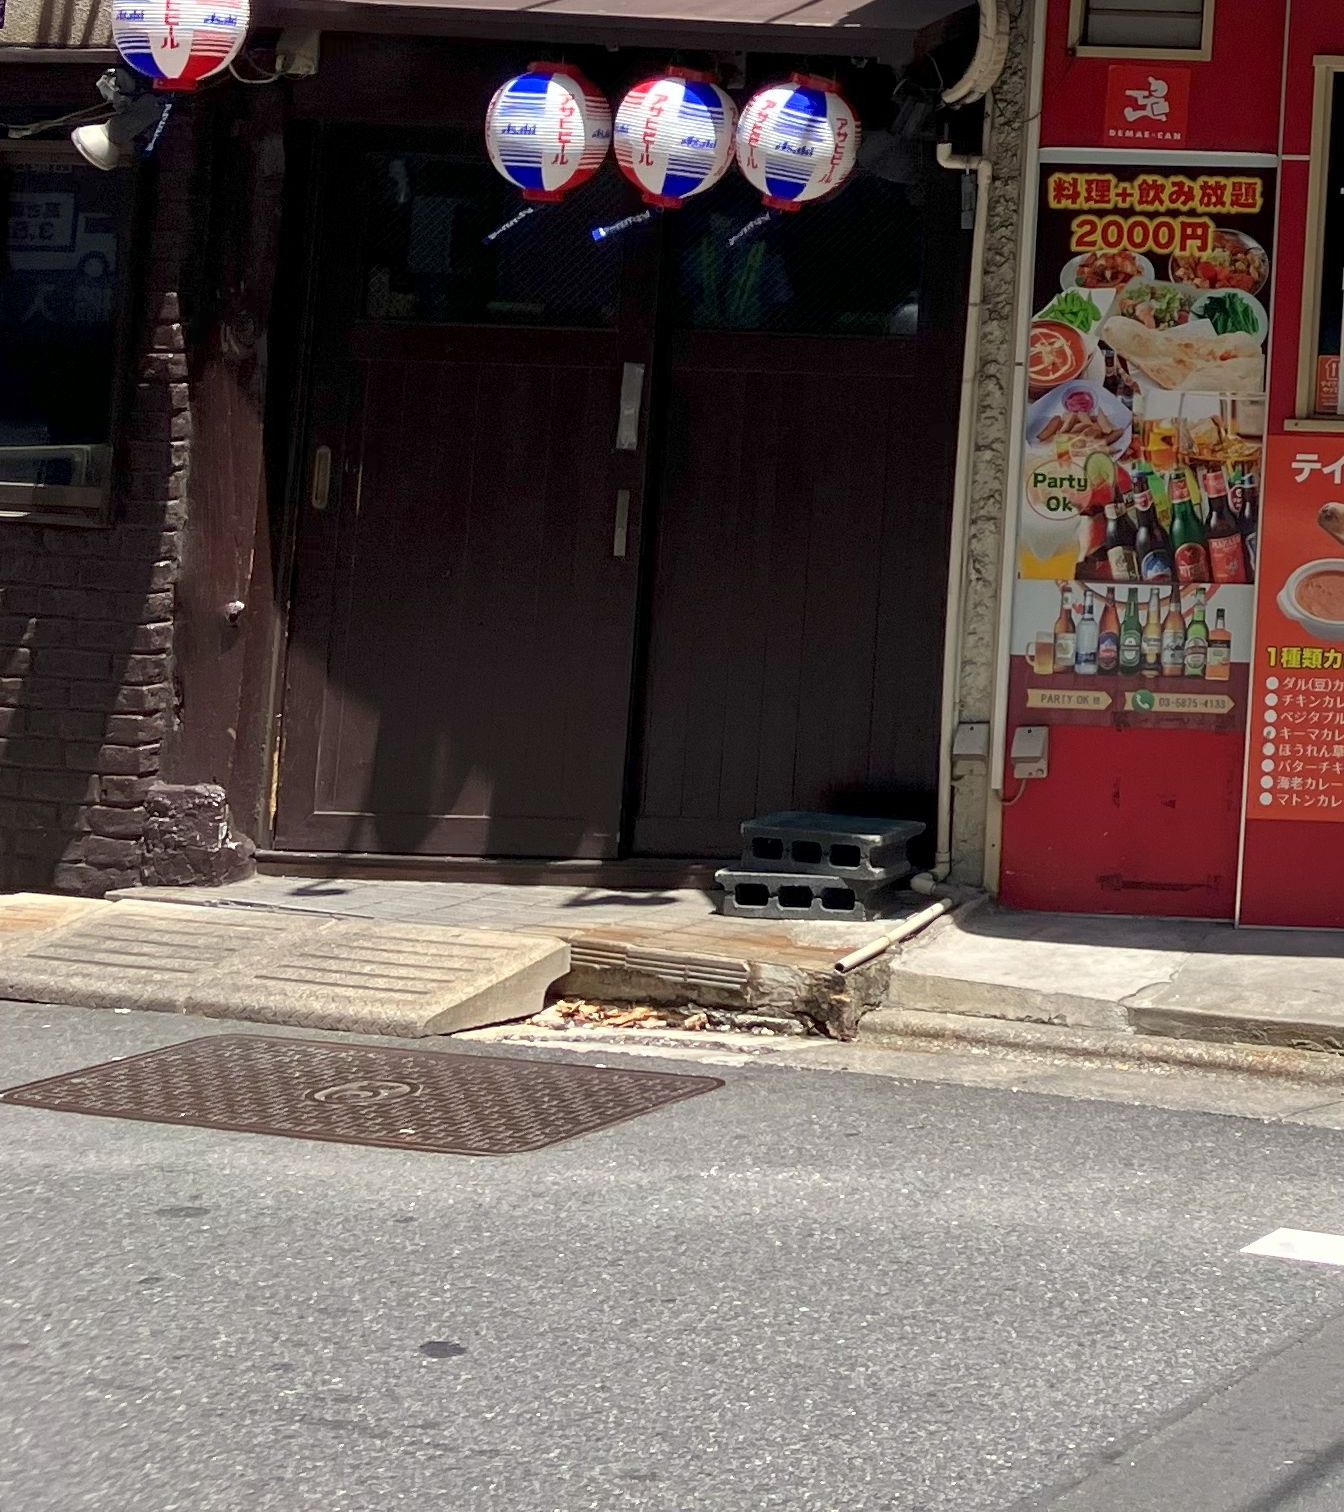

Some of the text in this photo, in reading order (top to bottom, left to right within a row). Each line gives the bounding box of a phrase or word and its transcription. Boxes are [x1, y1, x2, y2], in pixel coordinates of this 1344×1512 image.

[552, 92, 576, 166] アサヒビール
[639, 93, 668, 166] アサヒビール
[1051, 175, 1260, 211] 料理+飲み放題
[1074, 218, 1212, 253] 2000円
[1033, 472, 1088, 491] Party
[1046, 496, 1073, 512] Ok
[1040, 693, 1072, 705] PARTY
[1076, 694, 1090, 705] OK
[1276, 776, 1344, 791] 海老カレー
